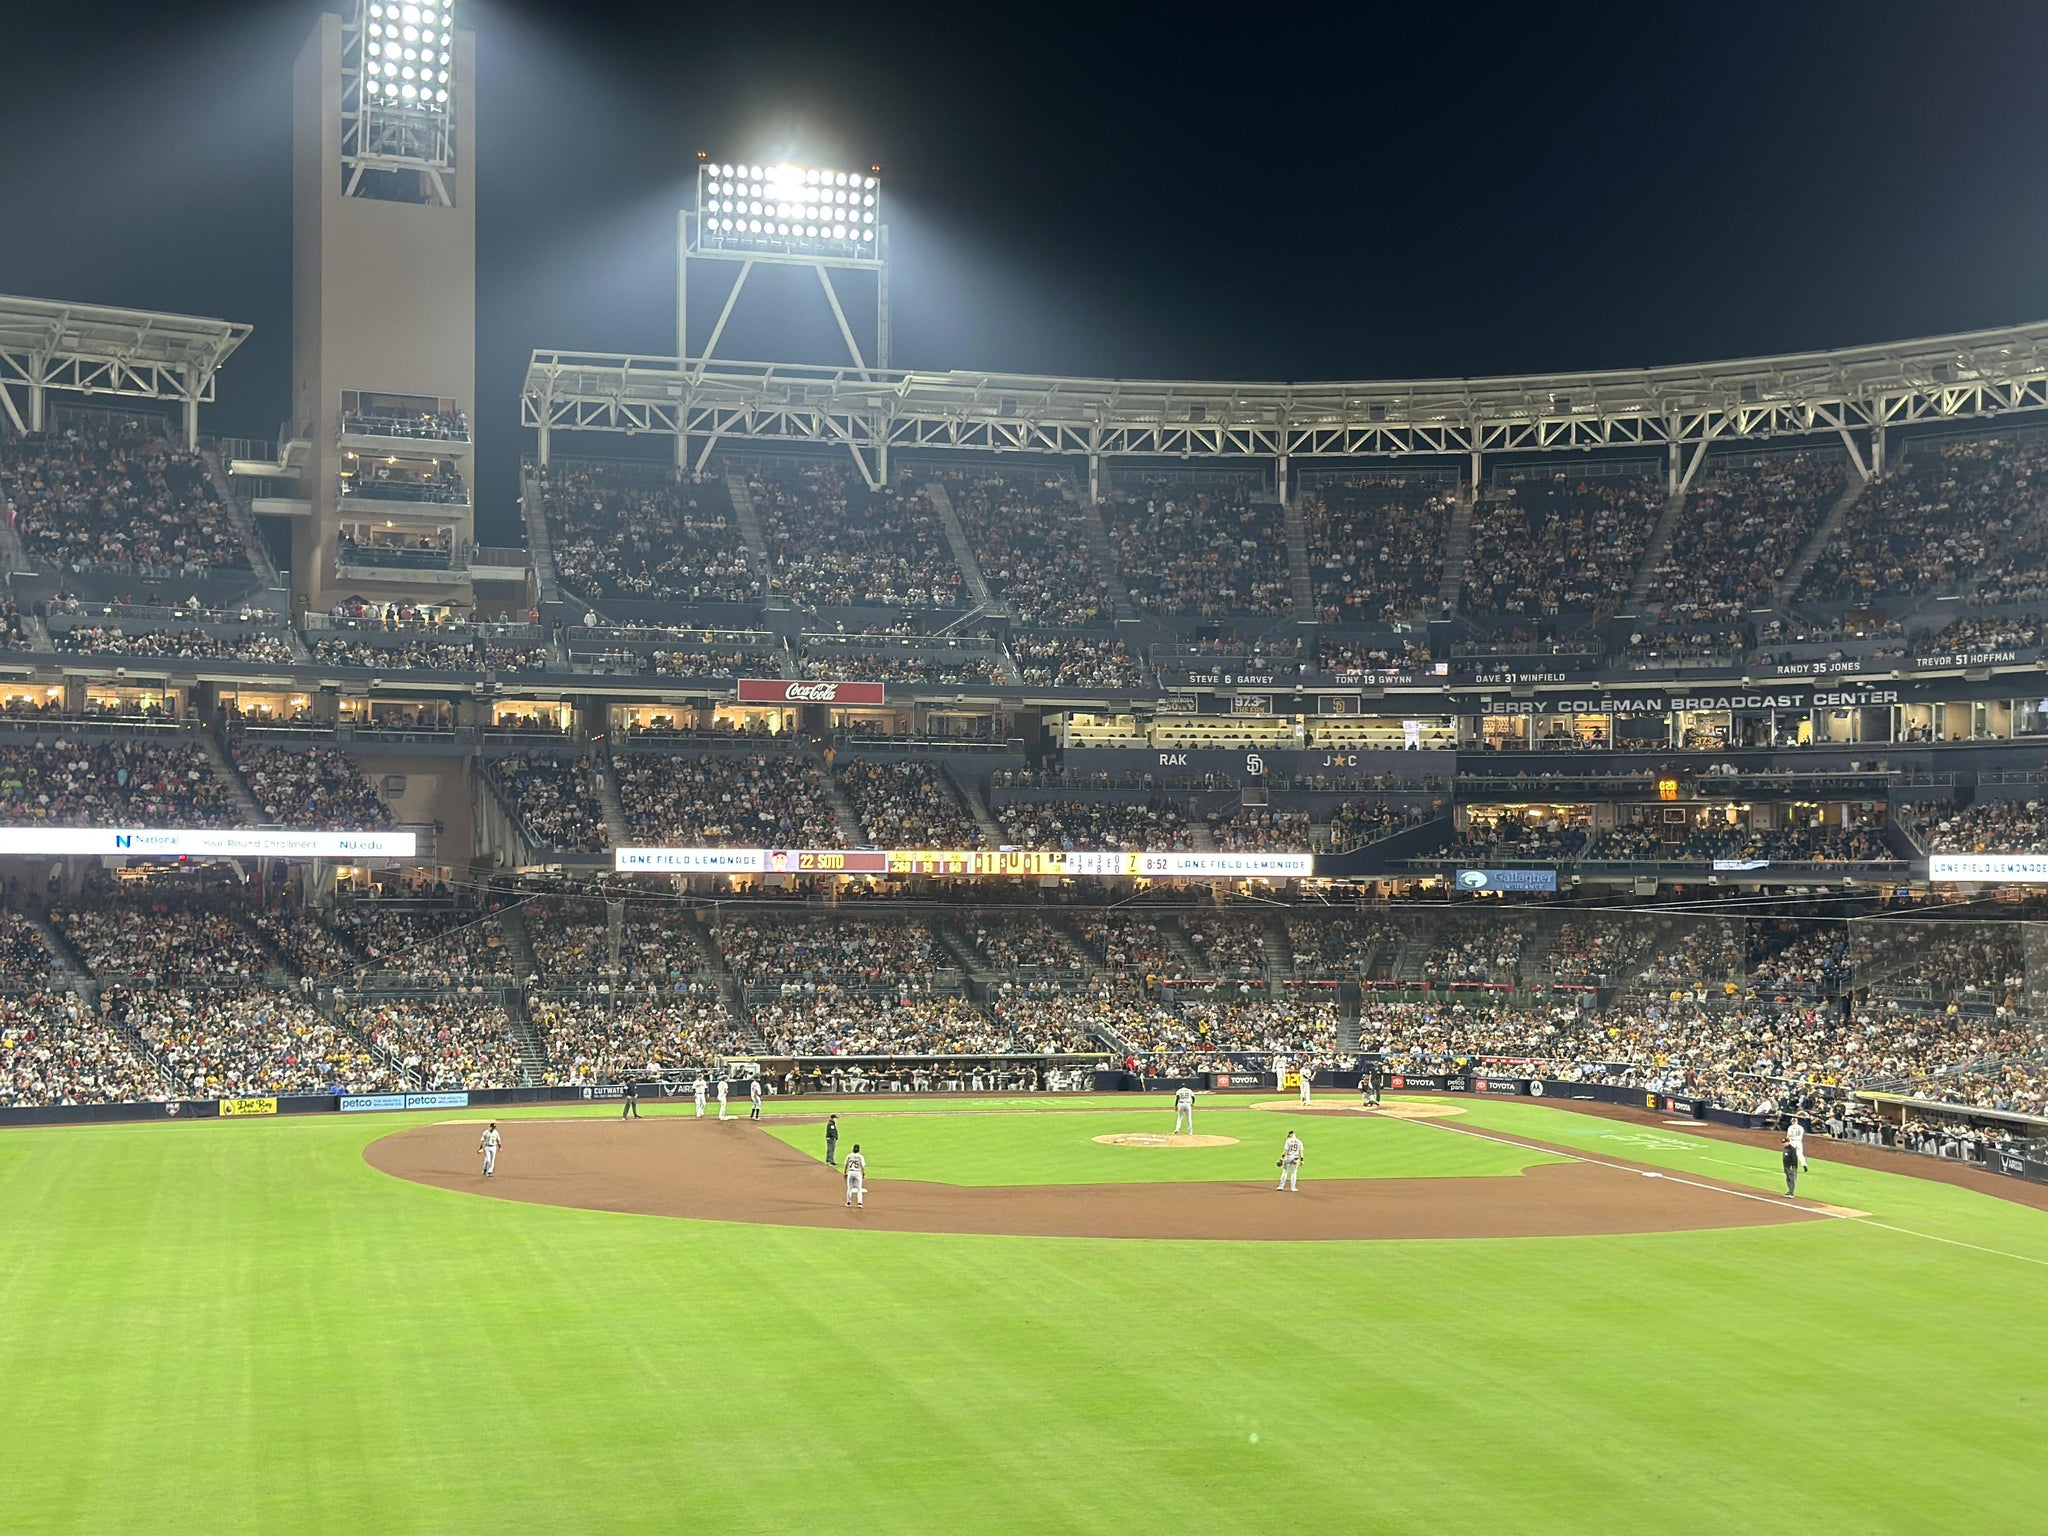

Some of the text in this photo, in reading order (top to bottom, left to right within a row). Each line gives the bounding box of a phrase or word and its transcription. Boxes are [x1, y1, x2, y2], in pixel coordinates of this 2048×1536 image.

[1916, 651, 2016, 667] TREVOR 51 HOFFMAN
[1777, 662, 1861, 674] RANDY 35 JONES
[1189, 675, 1273, 684] STEVE 6 GARVEY
[1335, 675, 1412, 684] TONY 19 GWYNN
[1475, 673, 1566, 683] DAVE 31 WINFIELD
[1481, 690, 1898, 713] JERRY COLEMAN BROADCAST CENTER
[1159, 754, 1187, 766] RAK
[116, 835, 131, 848] N
[622, 855, 757, 865] LANE FIELD LEMONADE
[800, 854, 844, 869] 22 SOTO
[1147, 859, 1167, 870] 8:52
[1178, 860, 1305, 869] LANE FIELD LEMONADE
[1935, 864, 2048, 873] LANE FIELD LEMONADE
[1494, 872, 1552, 883] Gallagher
[1231, 1076, 1258, 1084] TOYOTA
[1405, 1079, 1435, 1087] TOYOTA
[1488, 1082, 1515, 1090] TOYOTA
[342, 1098, 371, 1109] petco
[408, 1095, 437, 1106] petco
